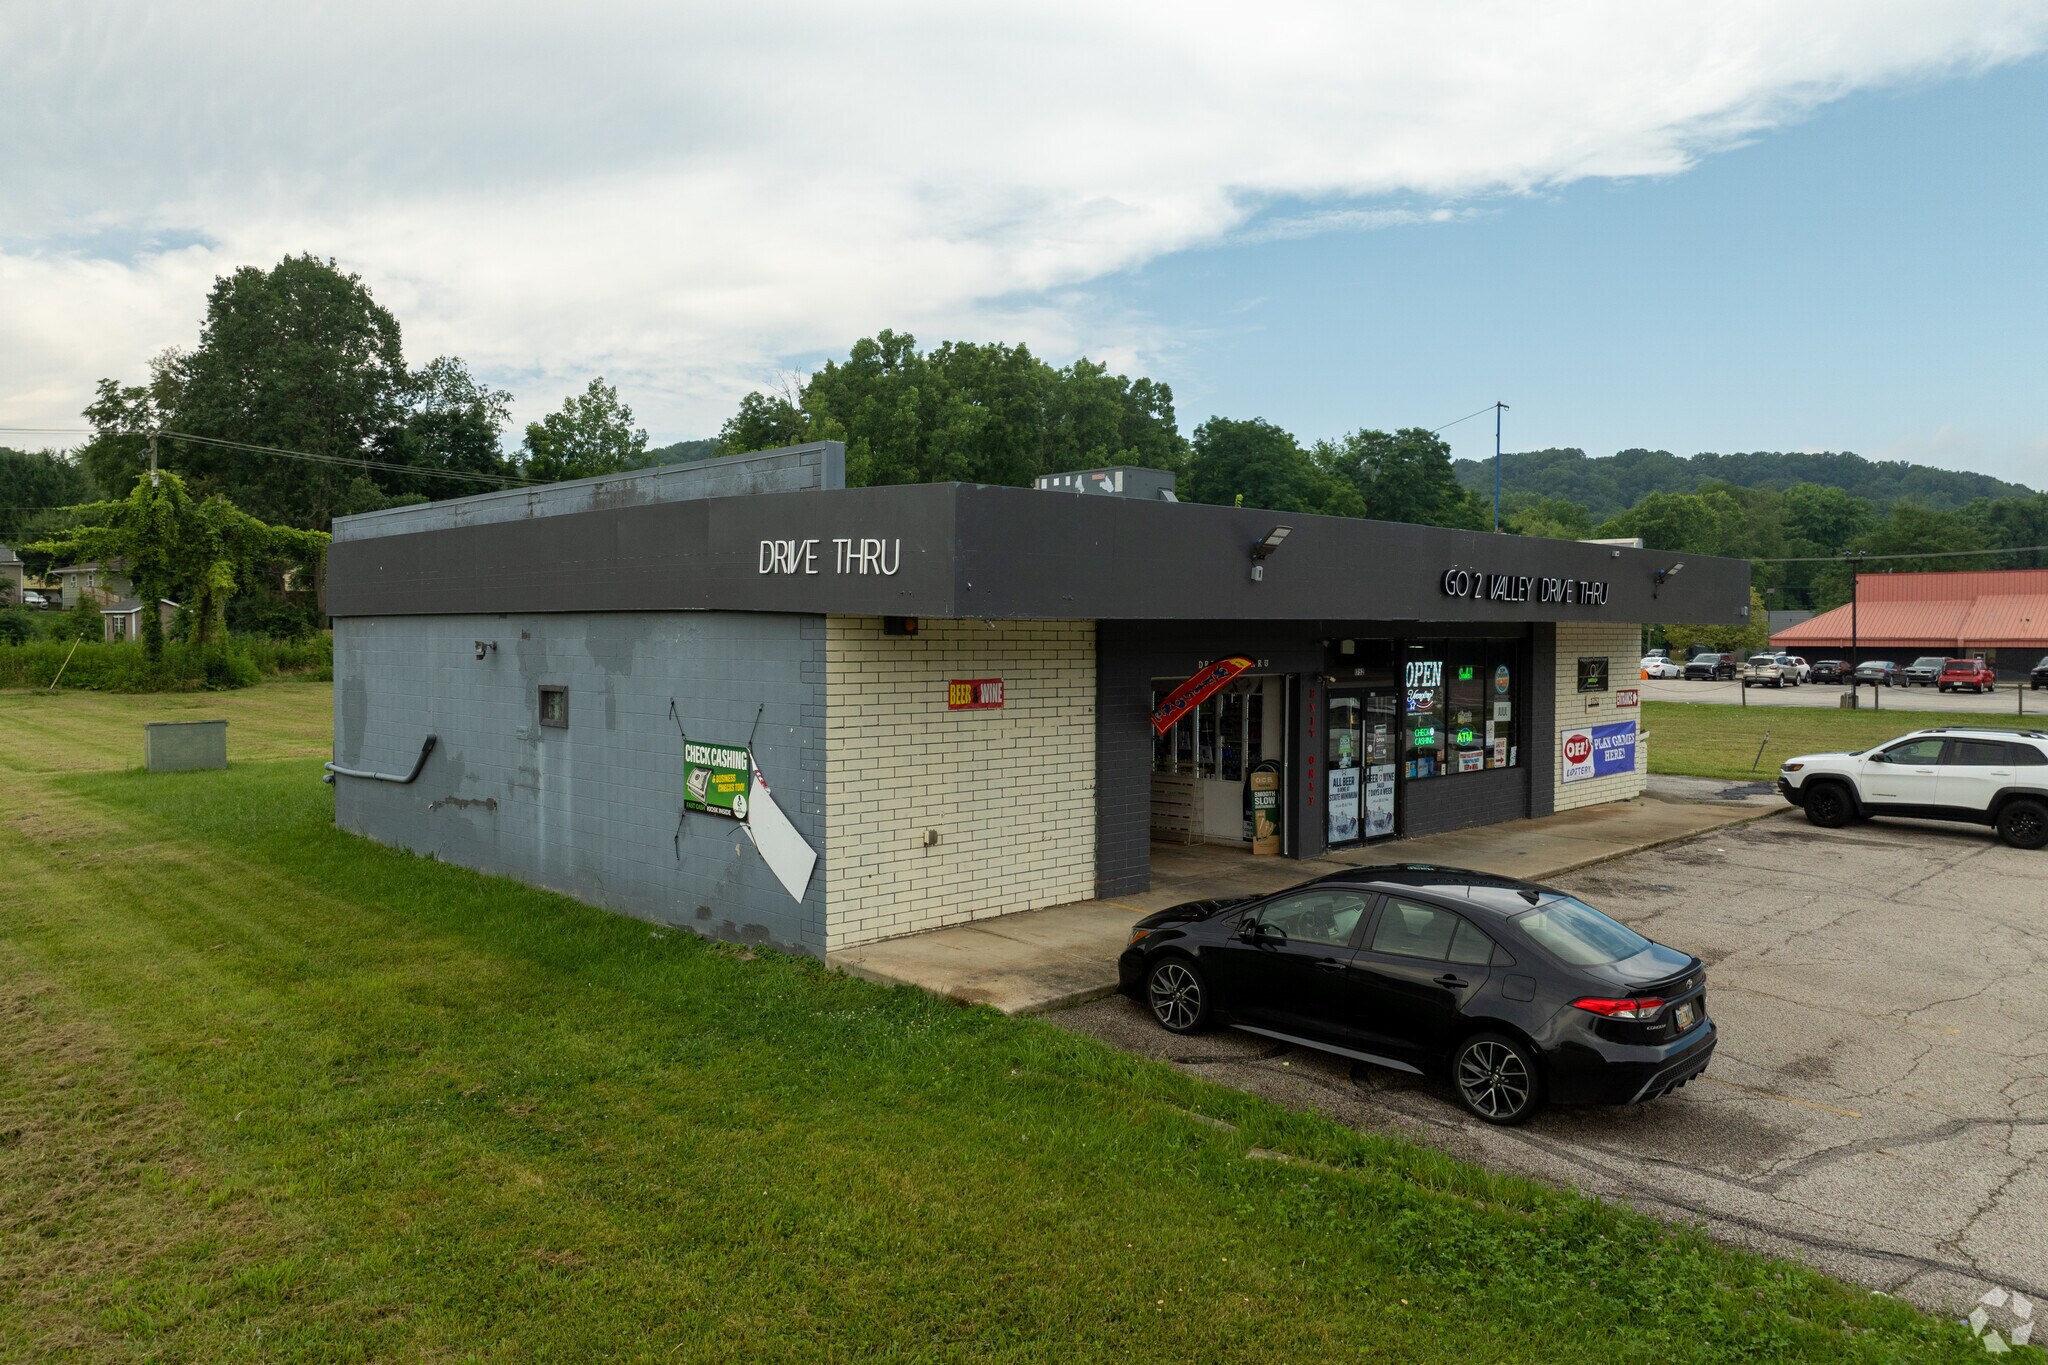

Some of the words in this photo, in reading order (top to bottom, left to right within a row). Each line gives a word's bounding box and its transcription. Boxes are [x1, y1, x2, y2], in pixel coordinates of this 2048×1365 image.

[759, 539, 820, 575] DRIVE
[832, 538, 901, 576] THRU
[1444, 569, 1470, 597] GO
[1474, 572, 1483, 599] 2
[1489, 574, 1534, 601] VALLEY
[1540, 577, 1574, 603] DRIVE
[1579, 581, 1609, 605] THRU
[1405, 661, 1443, 688] OPEN
[950, 684, 971, 705] BEER
[981, 682, 1003, 704] WINE
[1617, 691, 1633, 706] ENTRANCE
[1414, 737, 1435, 746] CASHING
[1456, 731, 1473, 744] ATM
[1594, 736, 1611, 750] PLAY
[1612, 733, 1635, 747] GAMES
[1567, 739, 1589, 758] OH!
[1604, 748, 1625, 762] HERE!
[685, 744, 711, 765] CHECK
[711, 748, 747, 770] CASHING
[1383, 773, 1394, 782] WINE
[1566, 765, 1592, 777] LOTTERY
[716, 773, 736, 783] BUSINESS
[1308, 754, 1316, 806] ONLY
[1333, 777, 1342, 788] ALL
[1343, 776, 1354, 786] BEER
[718, 783, 735, 793] CHECKS
[1254, 790, 1276, 798] SMOOTH
[1383, 787, 1392, 795] WEEK
[1254, 796, 1276, 806] SLOW
[719, 808, 731, 816] INSIDE
